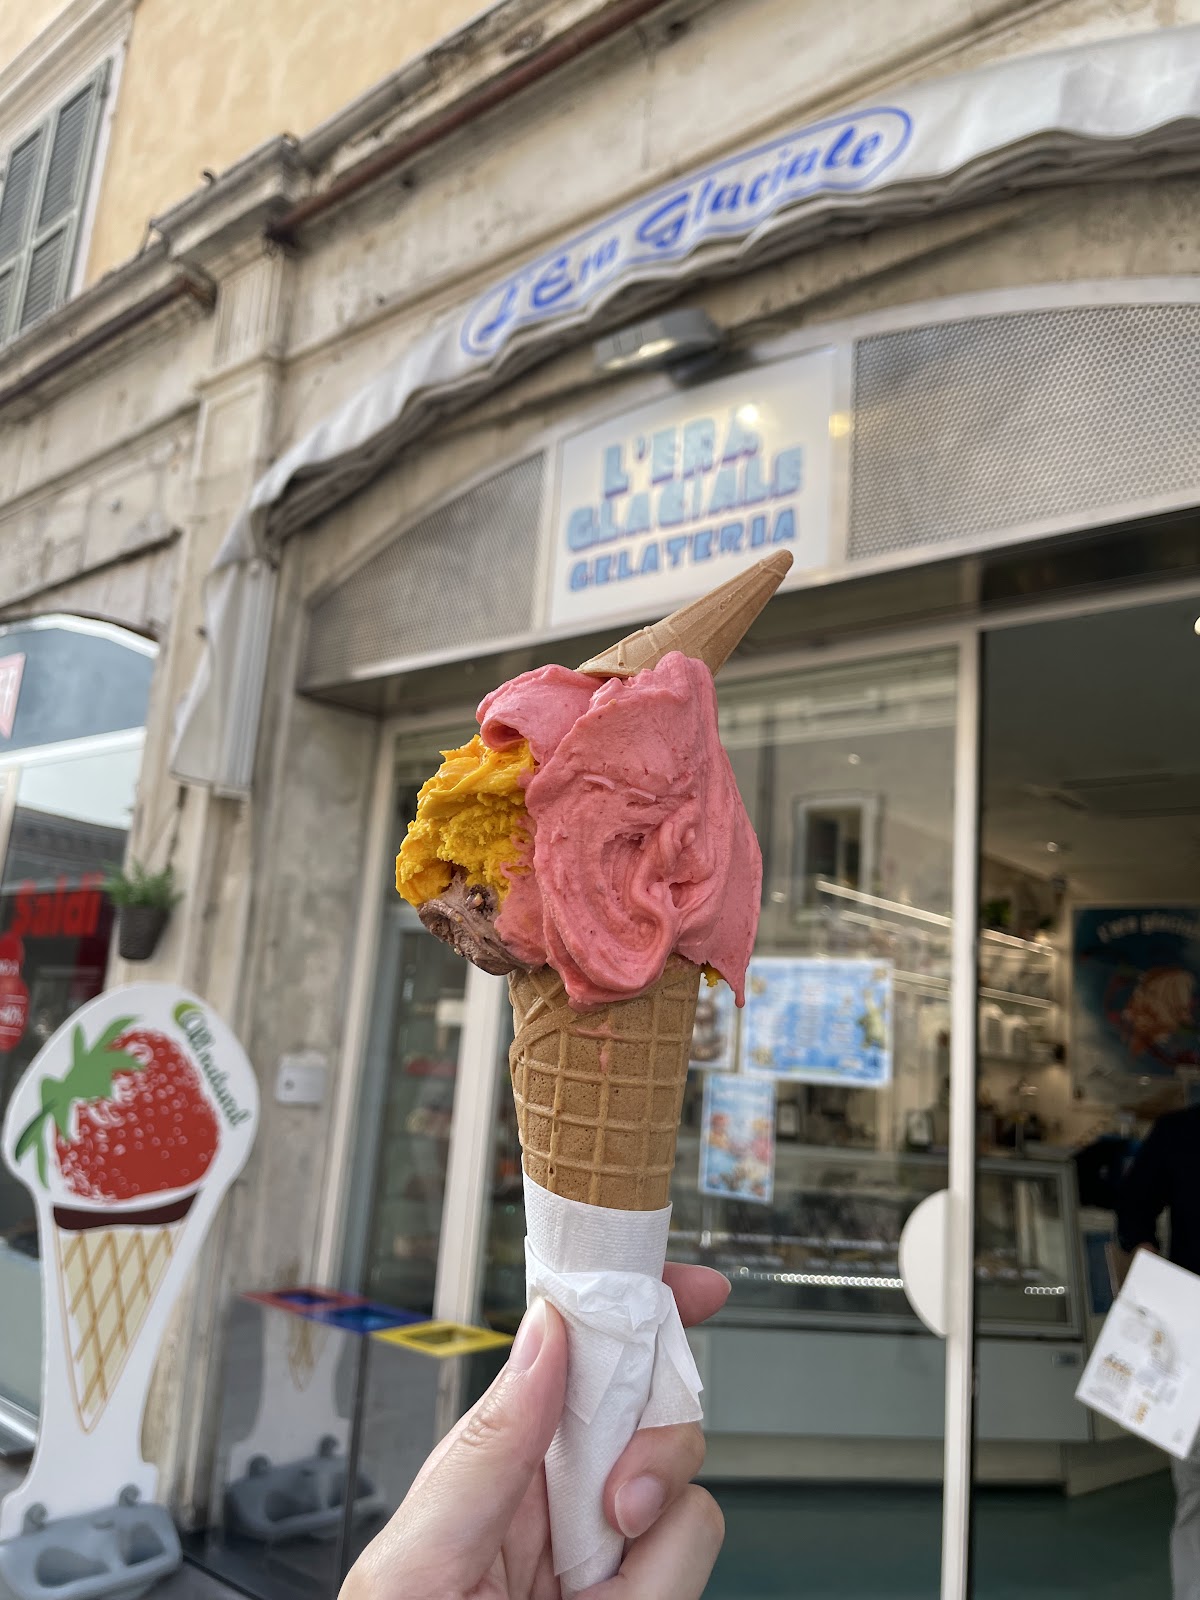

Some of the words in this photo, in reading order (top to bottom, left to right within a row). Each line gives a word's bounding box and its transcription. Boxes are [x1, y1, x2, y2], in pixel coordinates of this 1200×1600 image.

[636, 125, 882, 249] Glaciale
[566, 447, 803, 553] GLACIALE
[603, 409, 760, 499] L'ERA
[569, 507, 796, 593] GELATERIA
